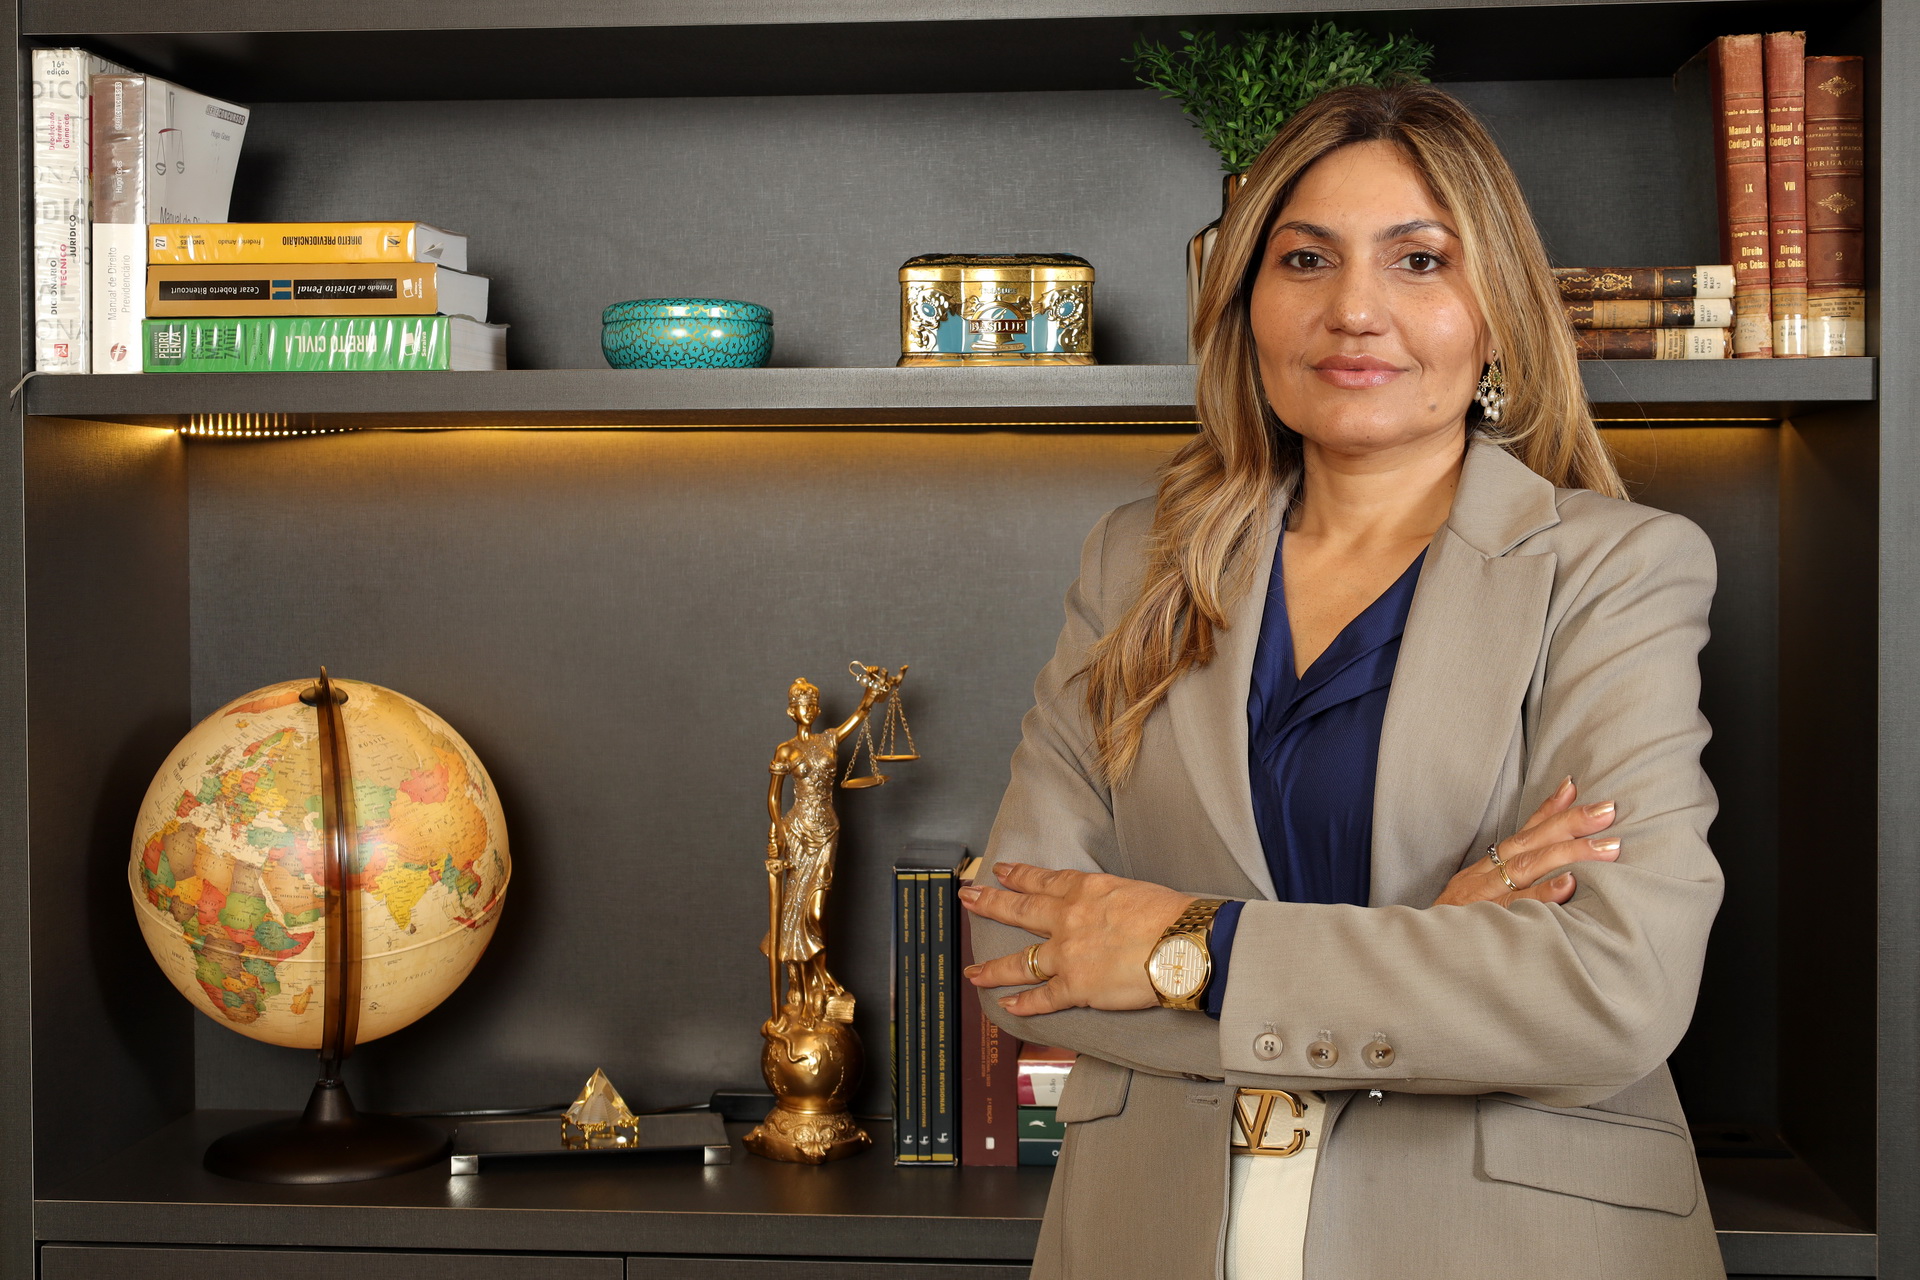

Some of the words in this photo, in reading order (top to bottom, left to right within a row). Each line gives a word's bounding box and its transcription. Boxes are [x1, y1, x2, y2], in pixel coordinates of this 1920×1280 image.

[1728, 124, 1752, 136] Manual
[1755, 124, 1763, 134] do
[1770, 122, 1793, 133] Manual
[1728, 138, 1750, 149] Codigo
[1769, 136, 1792, 147] Codigo
[115, 177, 123, 193] Hugo
[1744, 183, 1753, 193] IX
[1783, 181, 1796, 191] VIII
[68, 214, 77, 258] JURÍDICO
[282, 235, 337, 247] PREVIDENCIÁRIO
[337, 235, 363, 246] DIREITO
[155, 238, 166, 248] 27
[1741, 246, 1763, 257] Direito
[1780, 244, 1802, 255] Direito
[107, 247, 116, 274] Direito
[1834, 251, 1843, 261] 2
[1774, 259, 1786, 269] das
[108, 277, 116, 287] de
[120, 255, 131, 313] Previdenciário
[171, 286, 208, 296] Bitencourt
[209, 286, 237, 295] Roberto
[239, 286, 260, 295] Cezar
[297, 285, 324, 295] Penal
[325, 285, 357, 294] Direito
[367, 284, 394, 292] Tratado
[107, 290, 117, 320] Manual
[159, 332, 169, 359] PEDRO
[170, 331, 181, 359] LENZA
[295, 335, 327, 353] CIVIL
[990, 1025, 998, 1038] IBS
[938, 1049, 947, 1071] AÇÕES
